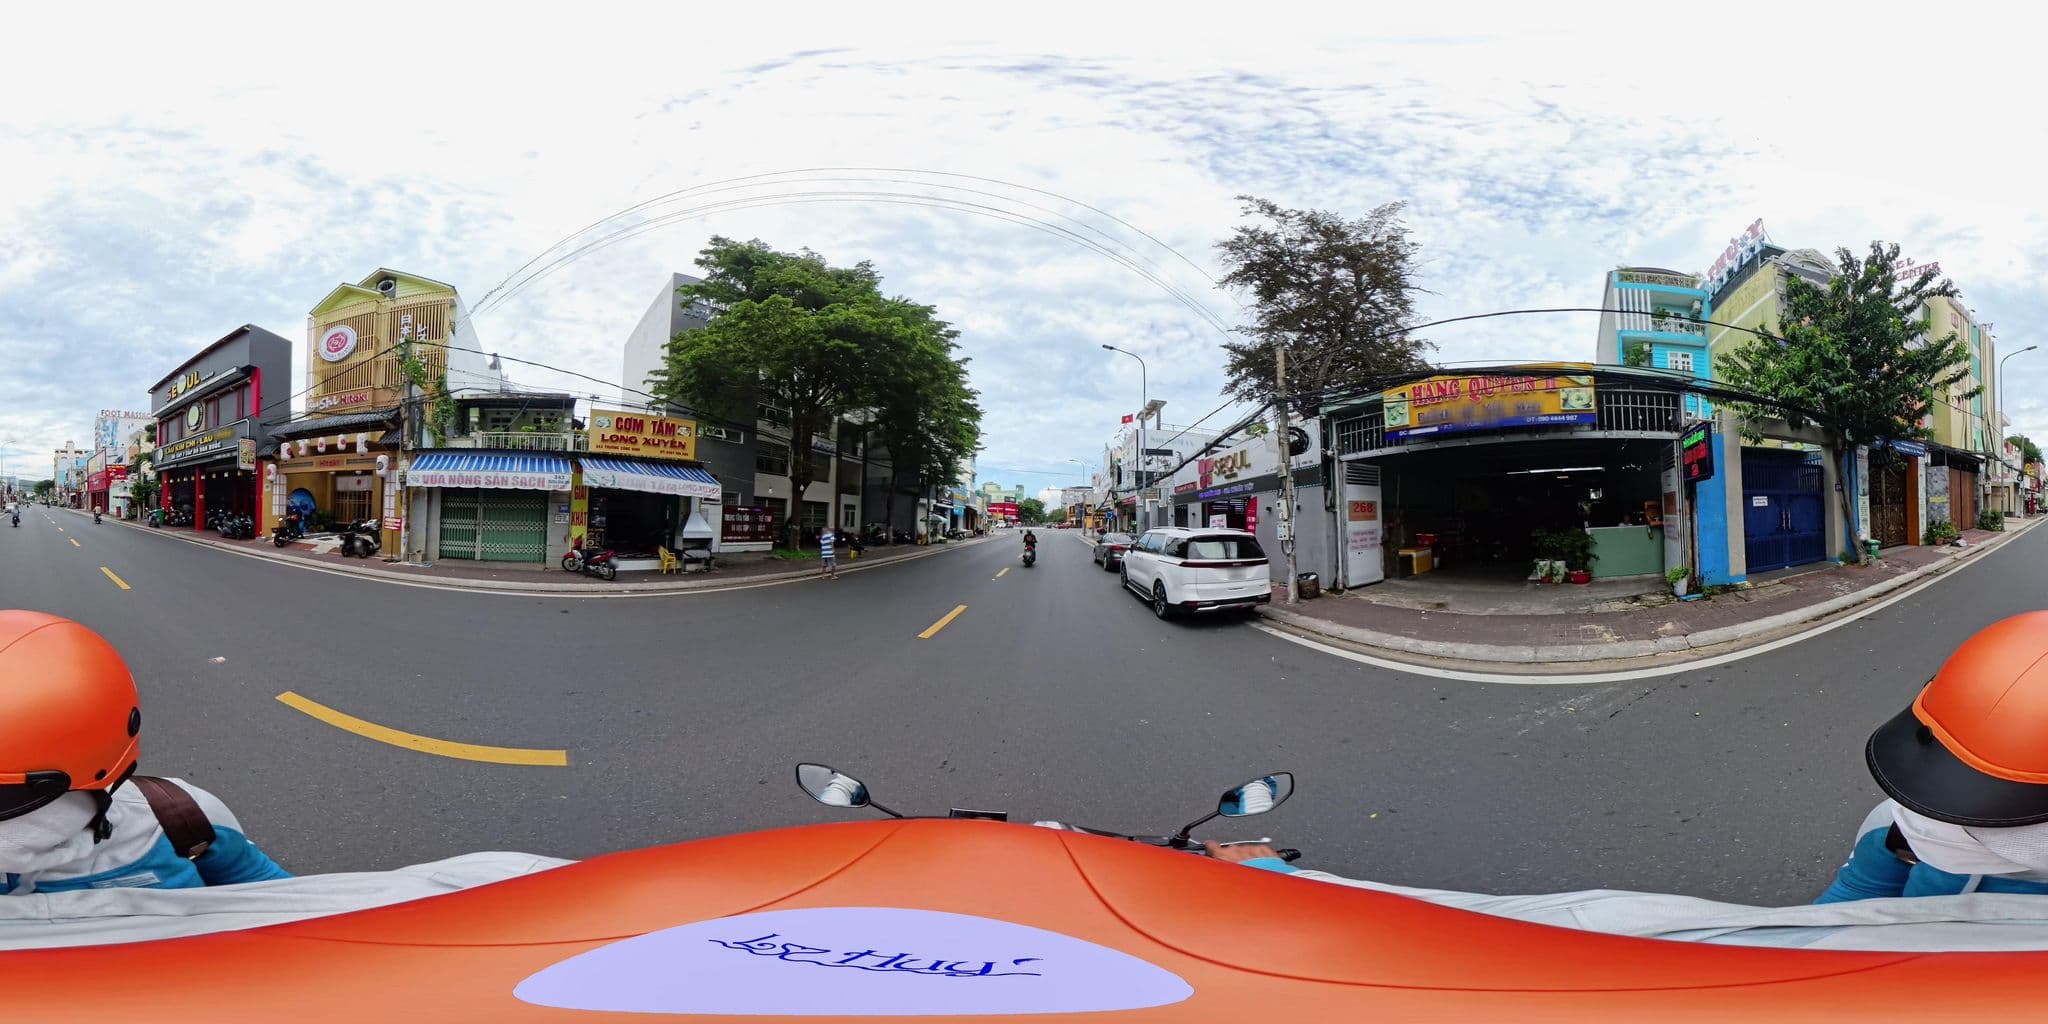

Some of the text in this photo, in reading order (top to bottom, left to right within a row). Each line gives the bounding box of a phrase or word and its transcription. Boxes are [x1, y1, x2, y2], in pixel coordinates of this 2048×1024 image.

[101, 409, 120, 417] FOOT
[615, 416, 676, 437] CƠM TẤM
[601, 434, 638, 445] LONG
[1214, 450, 1251, 476] SEOUL
[1353, 503, 1373, 513] 268
